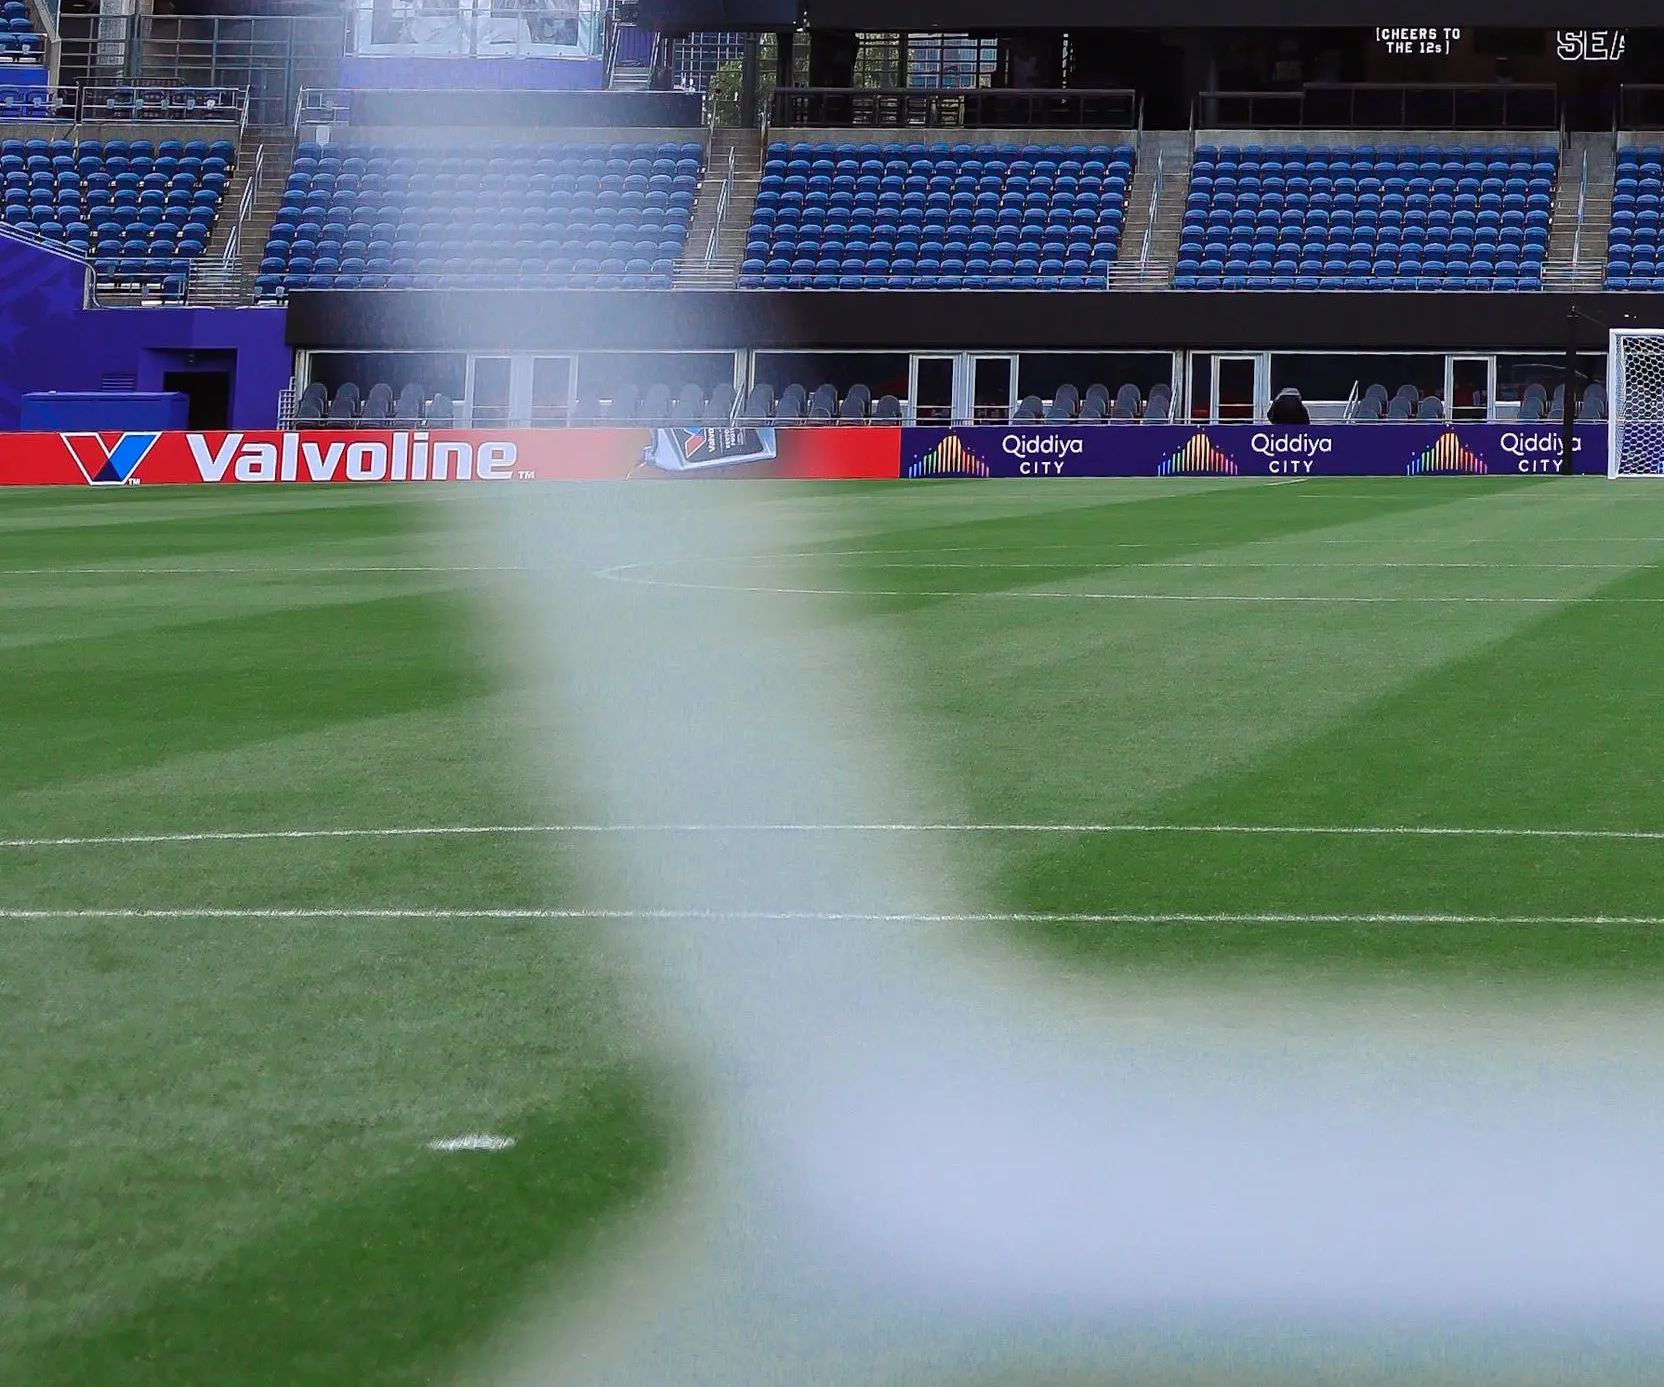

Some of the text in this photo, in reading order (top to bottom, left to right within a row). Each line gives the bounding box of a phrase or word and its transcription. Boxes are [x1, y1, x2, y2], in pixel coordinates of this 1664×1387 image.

[1376, 27, 1461, 41] [CHEERS TO
[1386, 41, 1413, 54] THE
[1002, 433, 1084, 458] Qiddiya
[1250, 433, 1333, 457] Qiddiya
[185, 430, 518, 483] Valvoline
[1019, 461, 1065, 475] CITY
[1268, 460, 1314, 474] CITY
[1518, 459, 1564, 472] CITY
